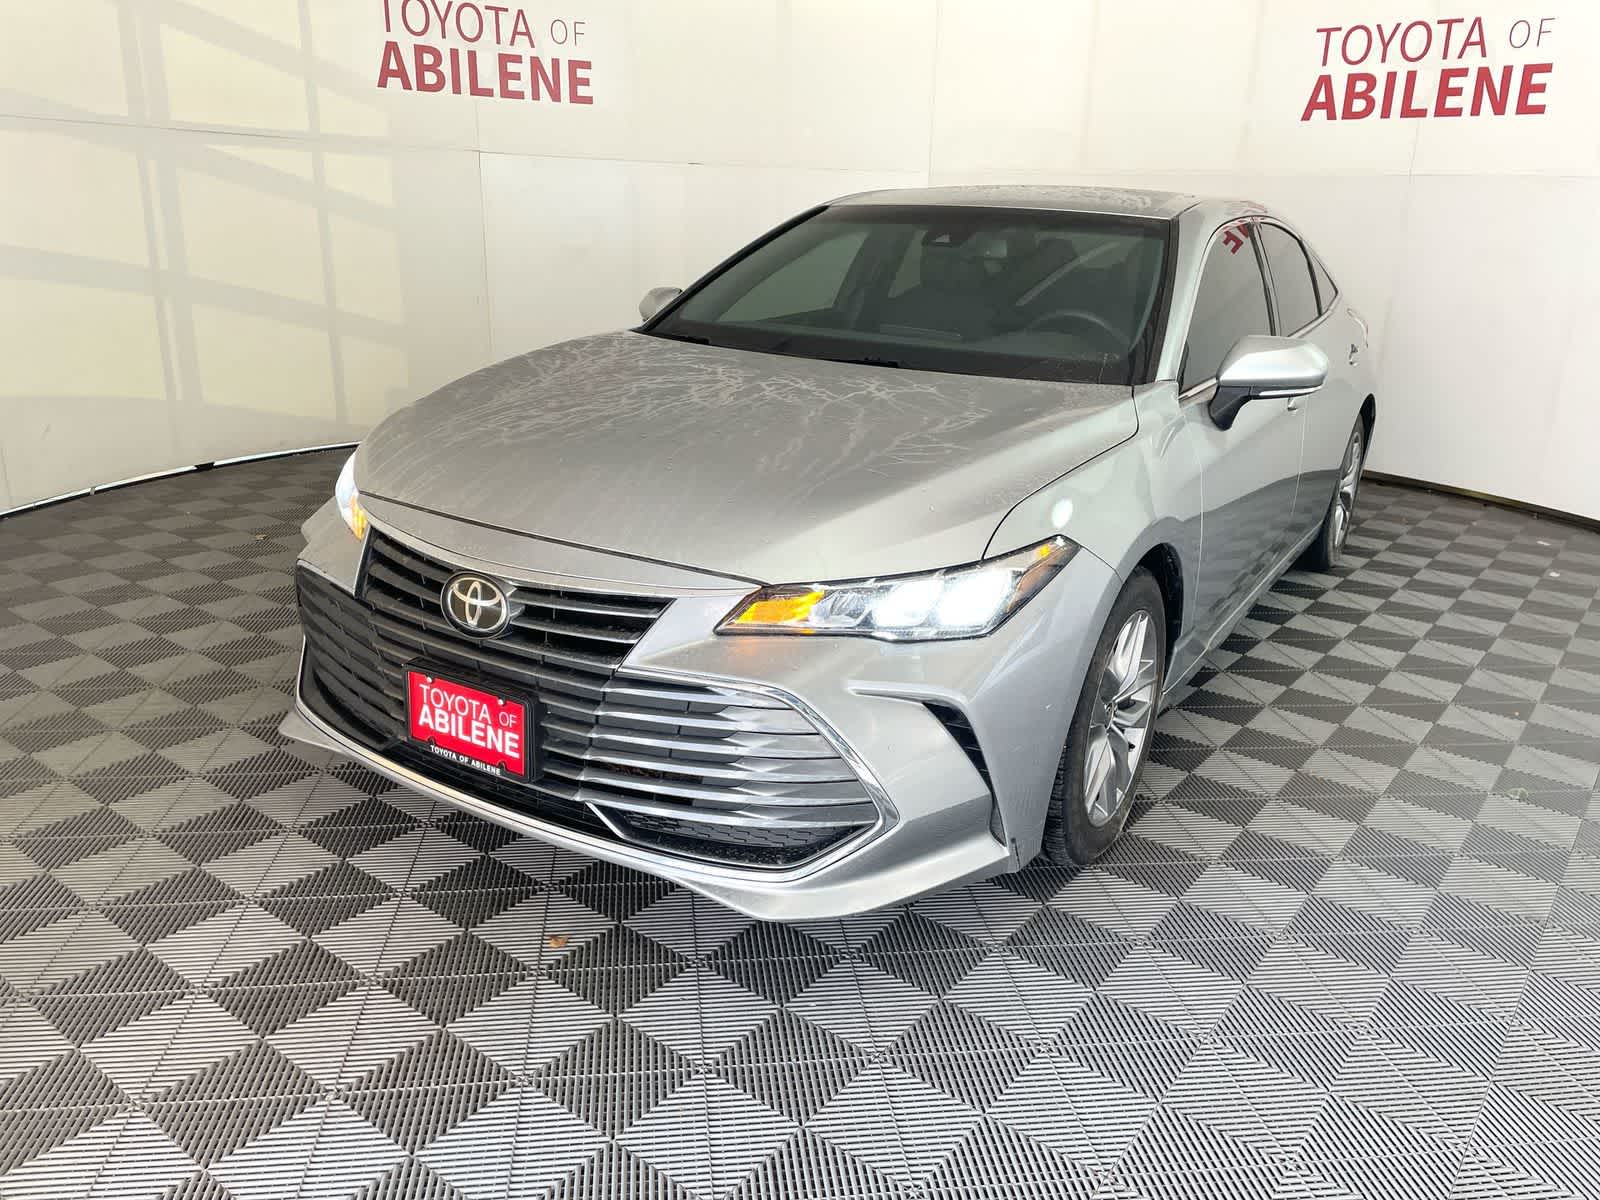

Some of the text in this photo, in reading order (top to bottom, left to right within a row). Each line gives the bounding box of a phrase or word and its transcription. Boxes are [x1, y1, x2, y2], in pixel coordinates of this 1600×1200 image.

[550, 19, 586, 46] OF
[1316, 16, 1556, 67] TOYOTA OF
[377, 41, 593, 104] ABILENE
[1301, 62, 1554, 121] ABILENE
[418, 704, 519, 758] ABILENE
[419, 684, 516, 727] TOYOTA OF
[430, 745, 500, 775] TOYOTA OF ABILENE
